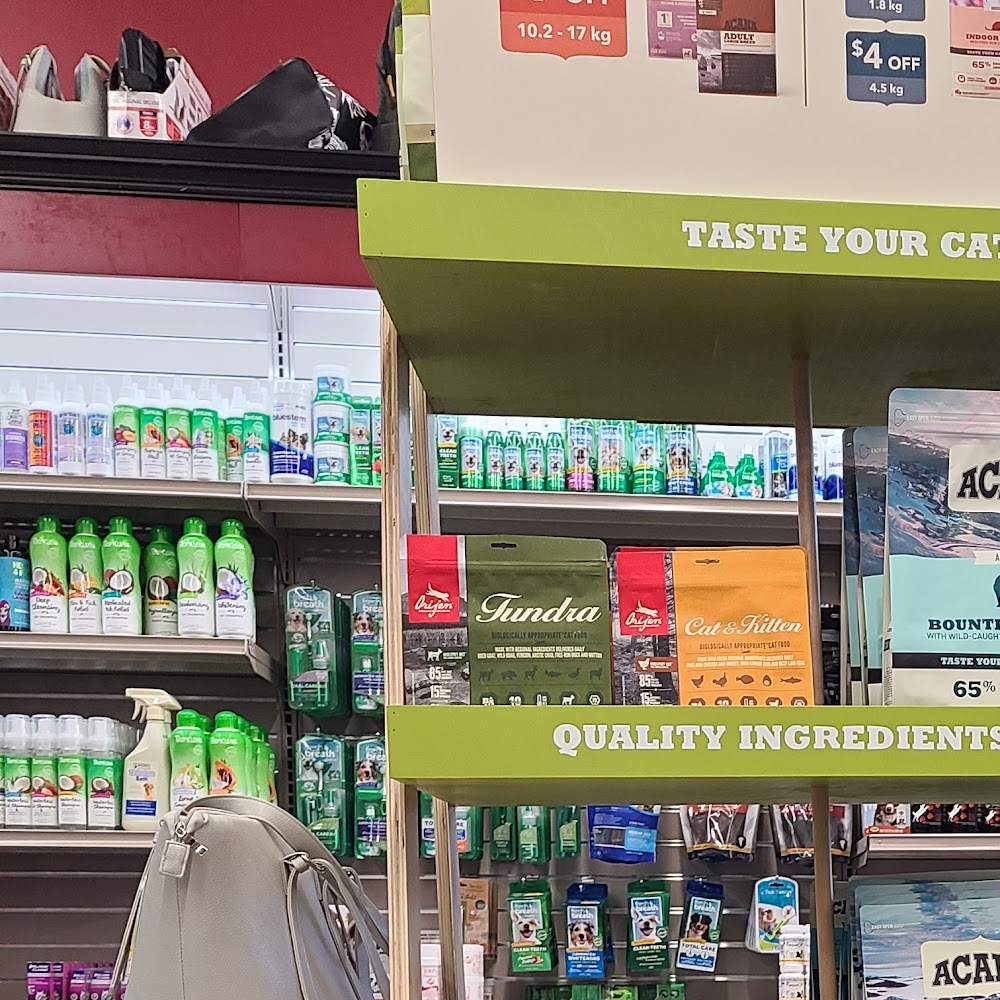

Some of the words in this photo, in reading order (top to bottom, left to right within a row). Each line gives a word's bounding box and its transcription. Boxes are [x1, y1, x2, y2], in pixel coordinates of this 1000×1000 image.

[869, 0, 884, 9] 1.8
[886, 0, 902, 13] kg
[517, 22, 553, 39] 10.2
[567, 25, 586, 40] 17
[591, 25, 612, 46] kg
[723, 33, 755, 41] ADULT
[851, 38, 882, 69] $4
[888, 56, 920, 71] OFF
[869, 83, 886, 93] 4.5
[889, 84, 903, 96] kg
[682, 221, 807, 252] TASTE
[819, 226, 929, 256] YOUR
[414, 595, 453, 614] Orijen
[475, 592, 601, 624] Tundra
[625, 611, 663, 632] Orijen
[685, 616, 724, 636] Cat
[725, 623, 736, 636] &
[736, 614, 803, 635] Kitten
[926, 632, 946, 640] WITH
[941, 657, 973, 666] TASTE
[953, 680, 996, 698] 65%
[552, 723, 727, 757] QUALITY
[681, 942, 699, 951] TOTAL
